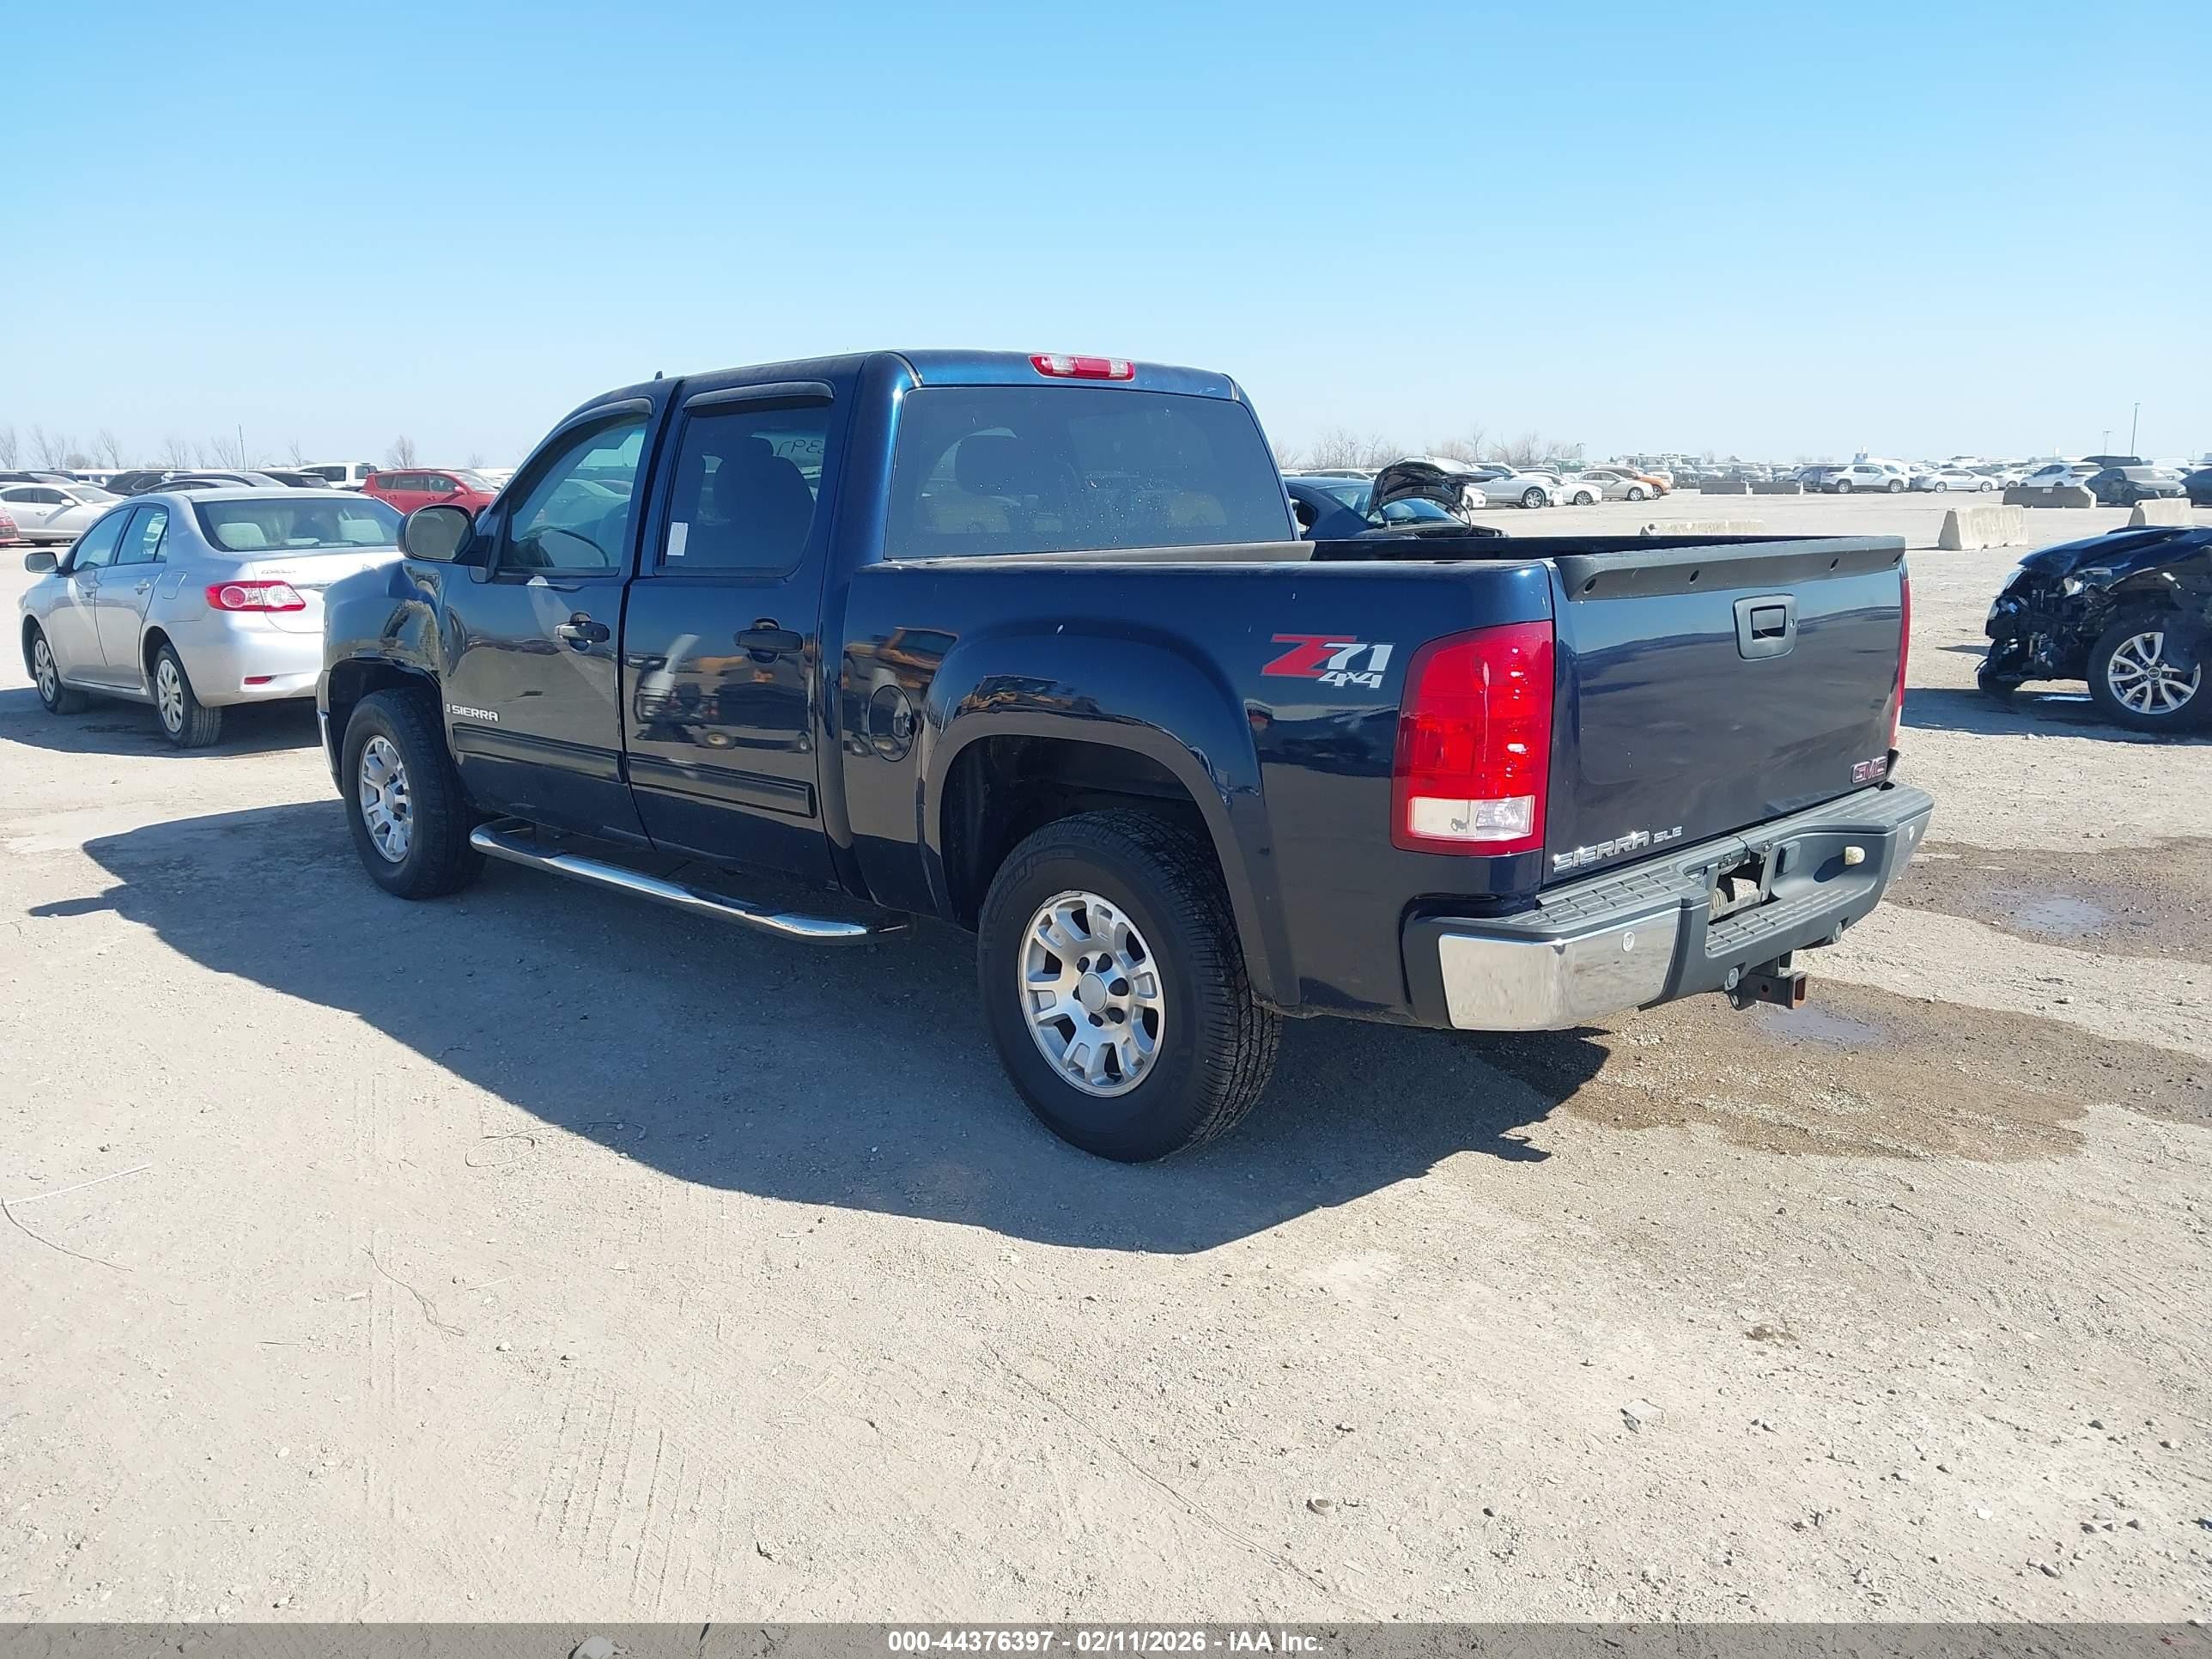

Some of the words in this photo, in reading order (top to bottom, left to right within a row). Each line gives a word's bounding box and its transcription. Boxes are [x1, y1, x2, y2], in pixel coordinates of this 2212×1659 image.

[1261, 633, 1395, 678] Z71
[452, 704, 498, 722] SIERRA
[1853, 757, 1887, 782] GMC
[1553, 830, 1650, 872] SIERRA
[1653, 826, 1682, 844] SLE
